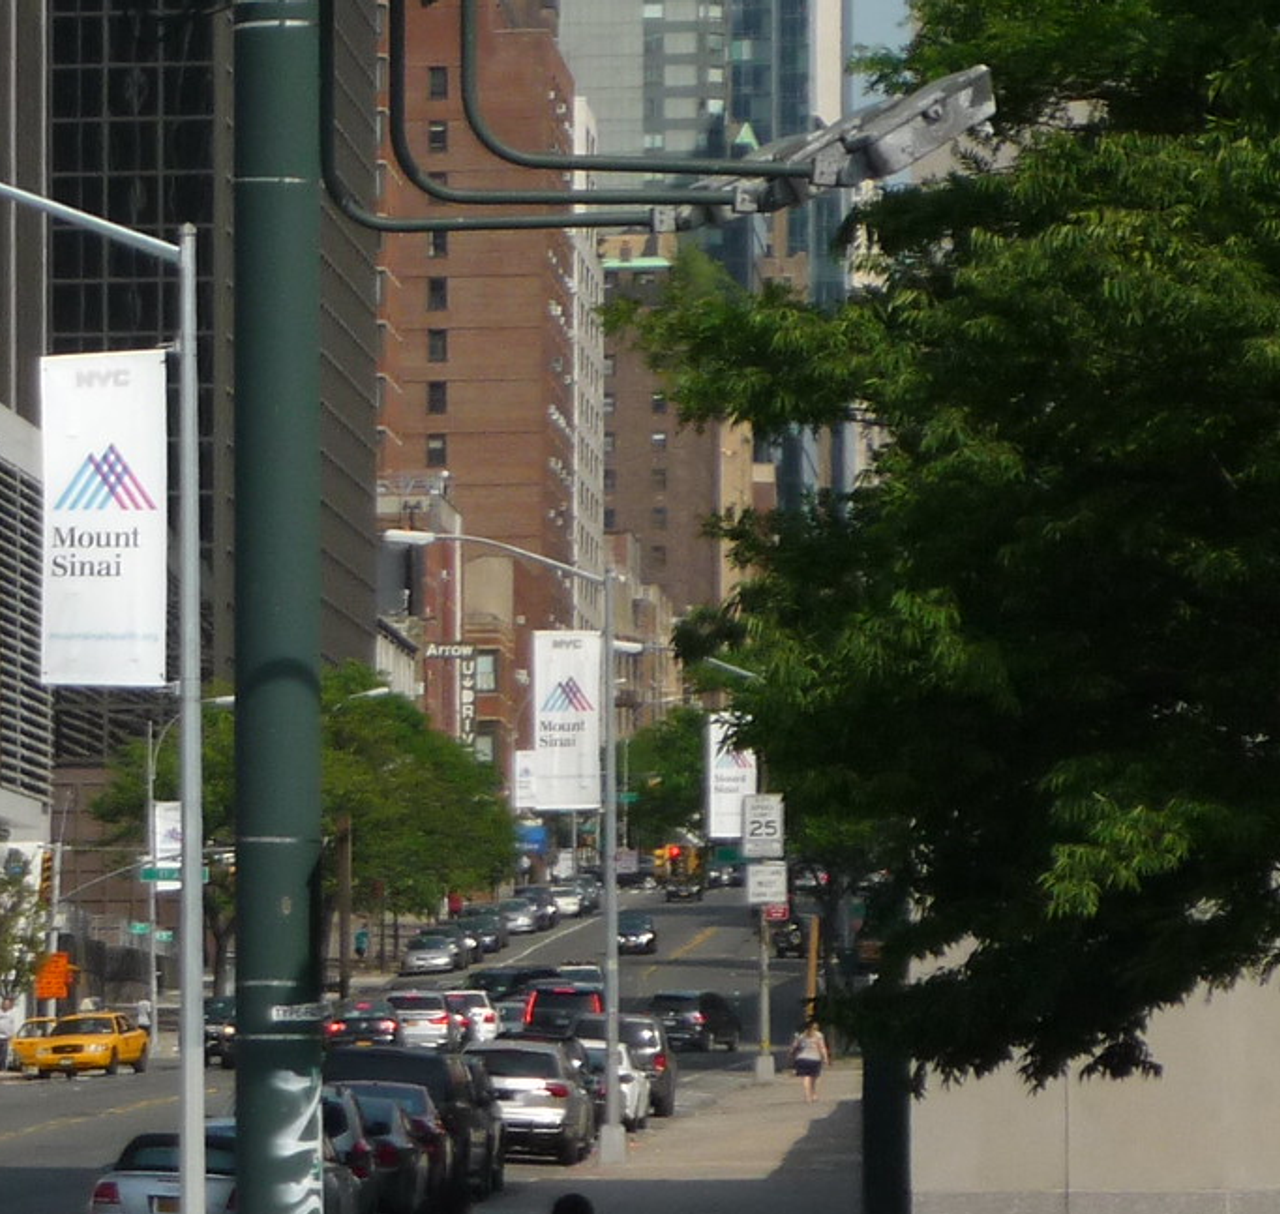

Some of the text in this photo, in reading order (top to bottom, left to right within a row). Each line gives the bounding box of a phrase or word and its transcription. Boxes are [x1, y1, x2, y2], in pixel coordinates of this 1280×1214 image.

[52, 526, 139, 549] Mount
[51, 553, 121, 577] Sinai
[426, 643, 473, 656] Arrow
[539, 720, 585, 733] Mount
[539, 734, 576, 748] Sinai
[750, 820, 777, 837] 25
